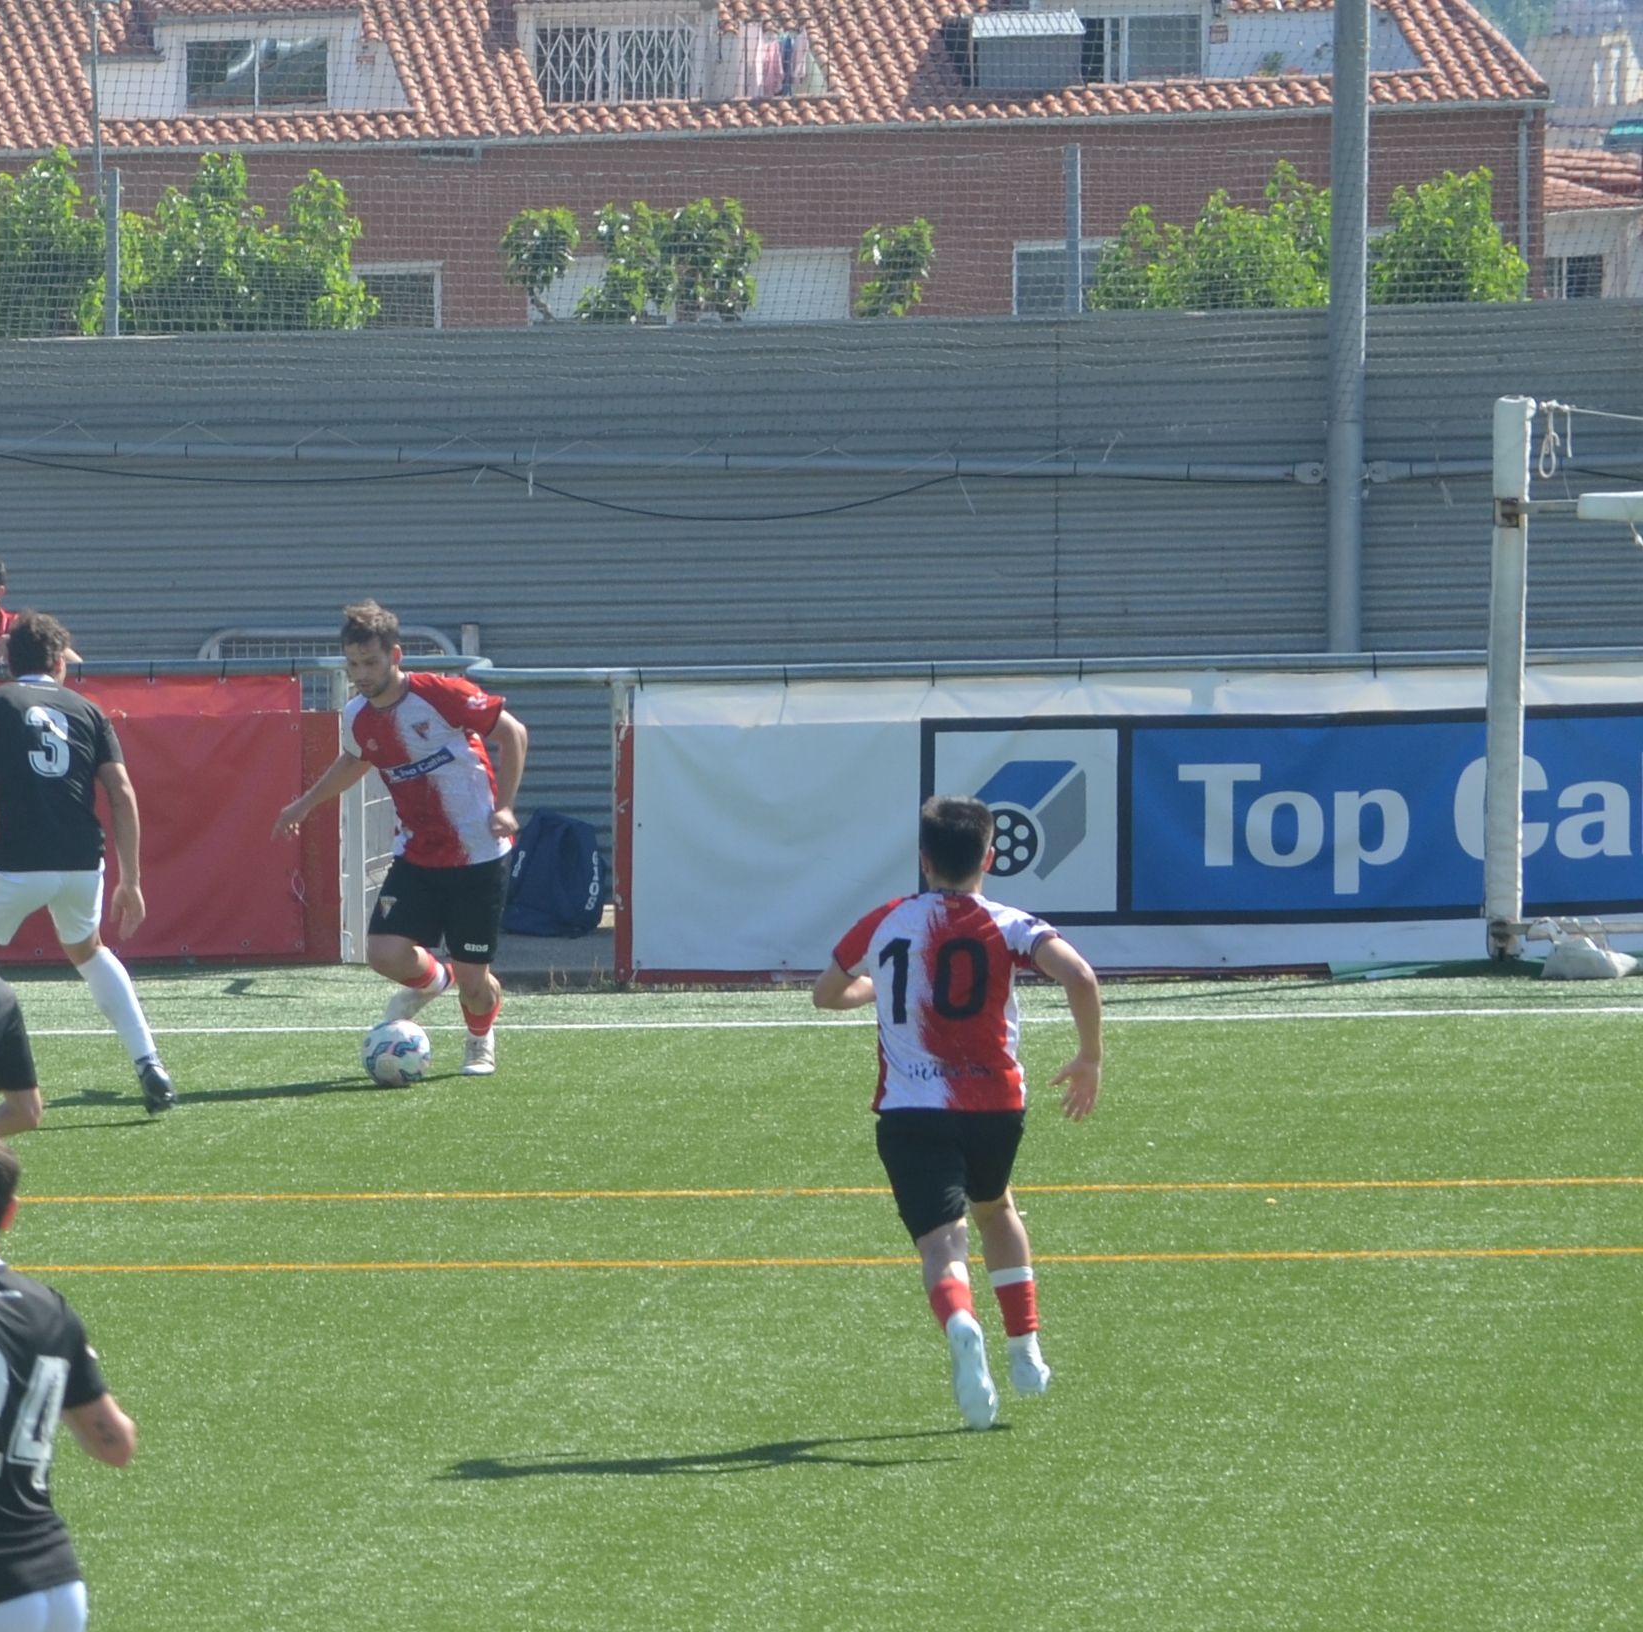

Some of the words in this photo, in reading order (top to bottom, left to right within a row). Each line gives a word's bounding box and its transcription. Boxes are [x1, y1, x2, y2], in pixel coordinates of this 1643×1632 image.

[25, 705, 70, 778] 3
[1177, 763, 1411, 895] Top
[1452, 752, 1643, 860] Ca
[878, 937, 989, 1025] 10
